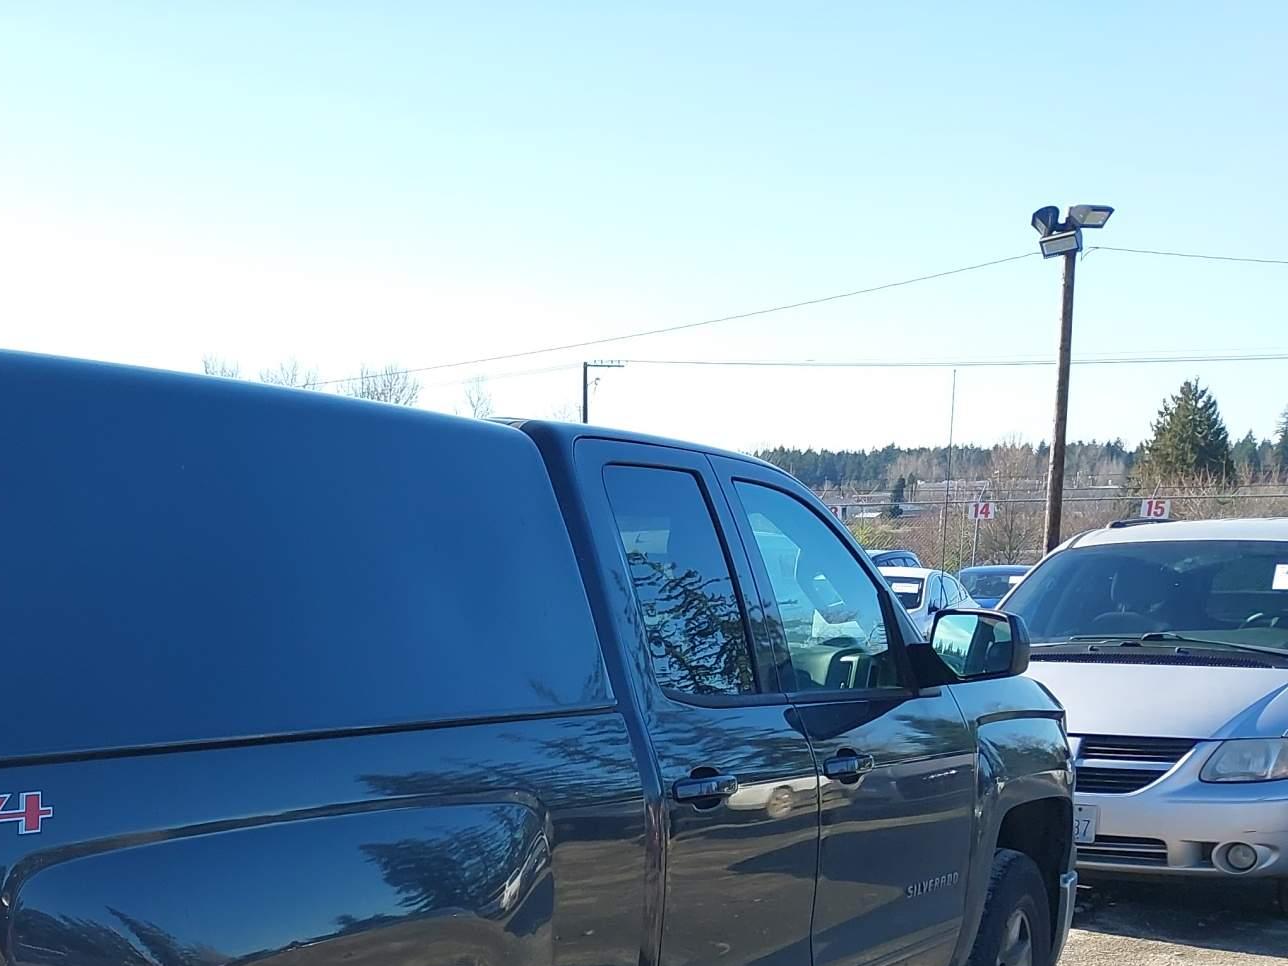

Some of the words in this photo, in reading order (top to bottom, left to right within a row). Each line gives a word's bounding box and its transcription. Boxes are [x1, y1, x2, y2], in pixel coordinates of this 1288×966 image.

[973, 503, 991, 519] 14
[1146, 501, 1165, 517] 15
[906, 871, 959, 899] SILVERADO
